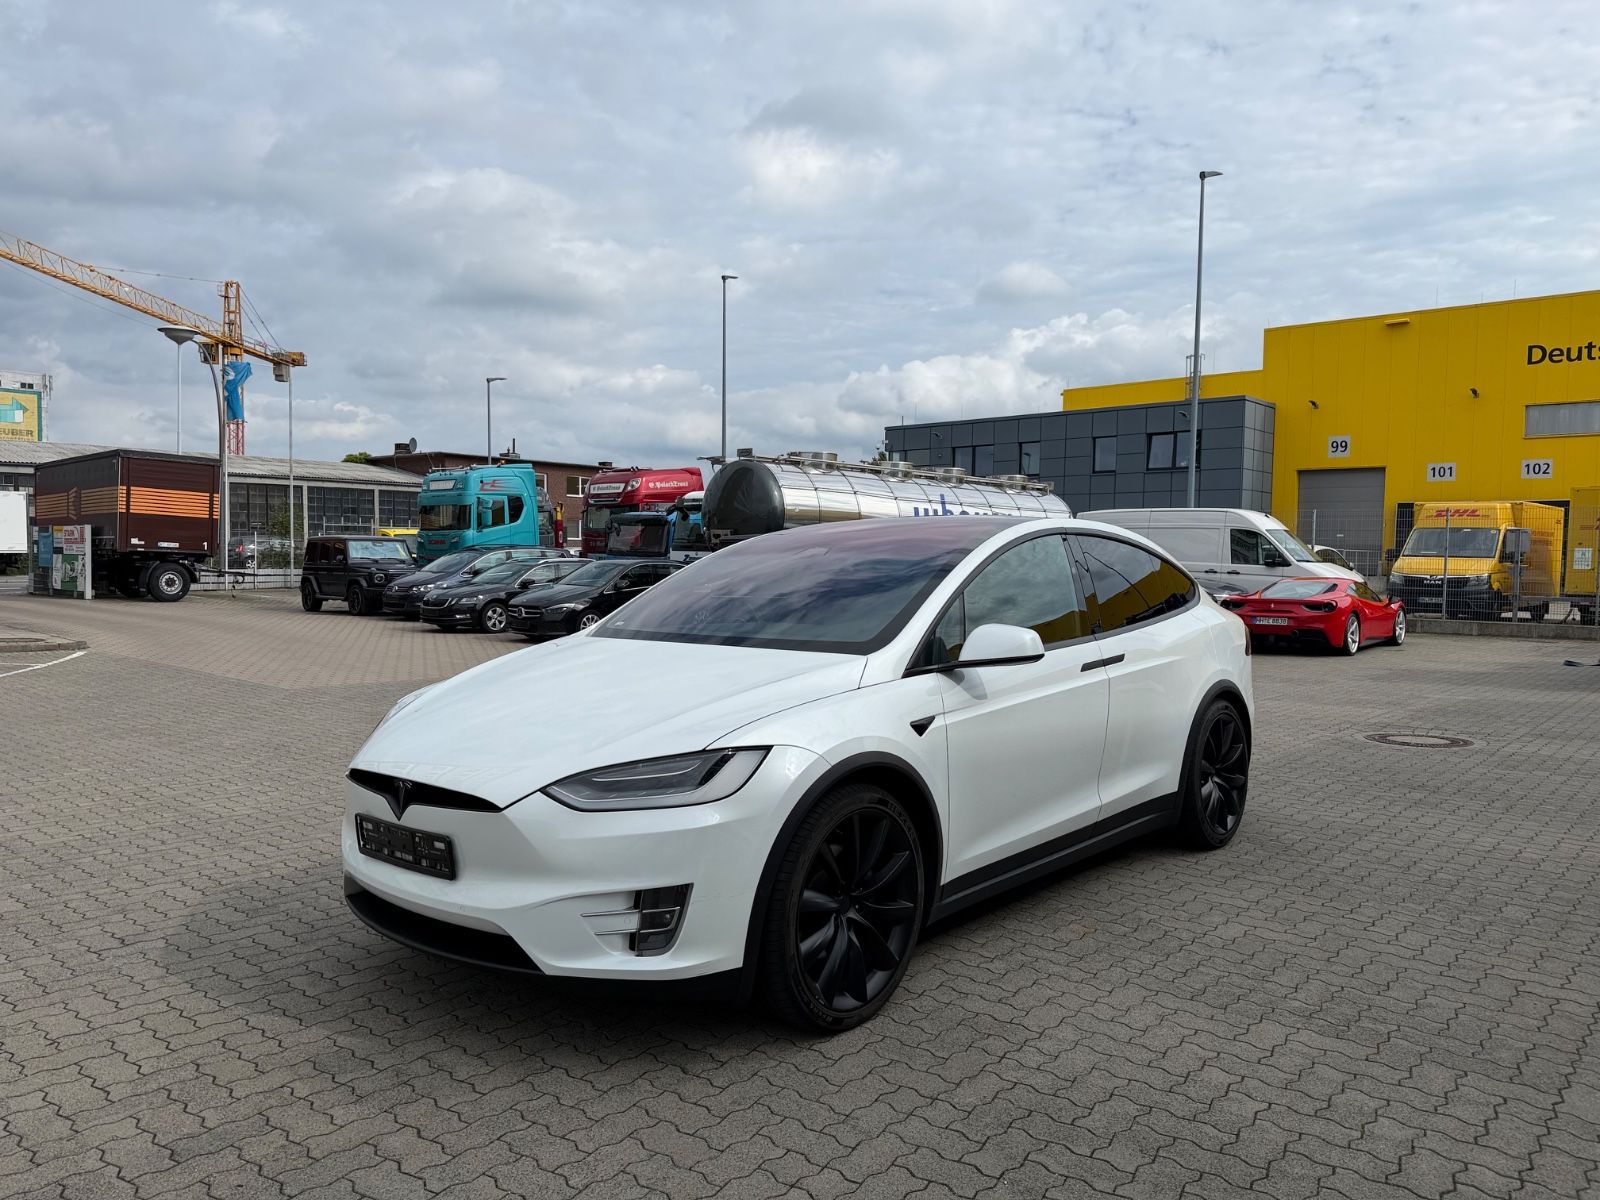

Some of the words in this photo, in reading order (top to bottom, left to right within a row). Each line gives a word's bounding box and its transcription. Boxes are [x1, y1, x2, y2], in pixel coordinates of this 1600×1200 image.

[1527, 341, 1600, 366] Deut
[1330, 440, 1348, 453] 99
[1430, 466, 1453, 478] 101
[1524, 462, 1550, 475] 102
[1433, 509, 1480, 518] DHL
[202, 542, 208, 550] 1
